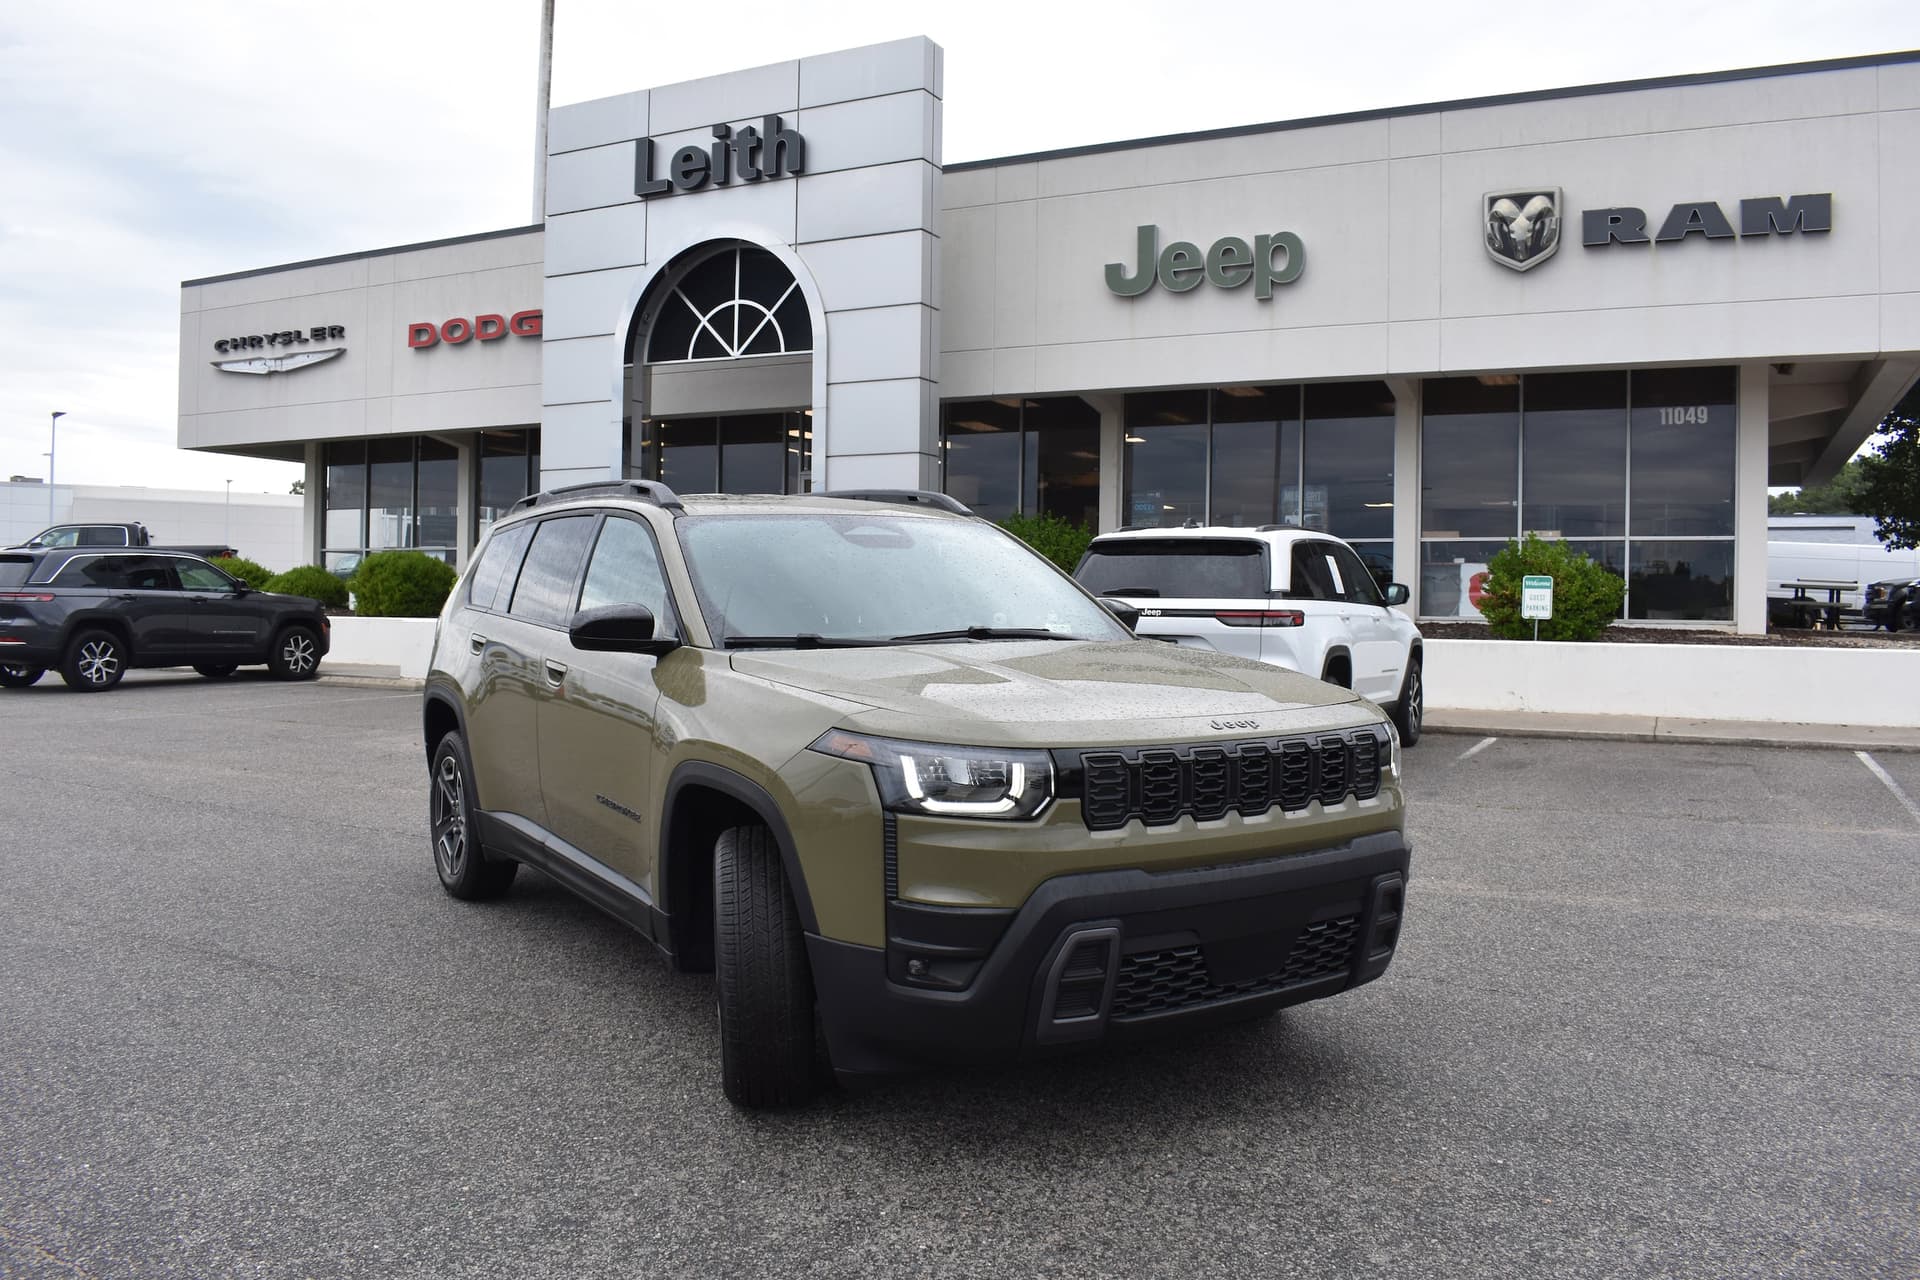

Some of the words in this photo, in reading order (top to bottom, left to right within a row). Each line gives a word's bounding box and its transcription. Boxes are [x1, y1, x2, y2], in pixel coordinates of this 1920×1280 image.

[634, 114, 805, 197] Leith
[1582, 193, 1832, 247] RAM
[1104, 224, 1306, 300] Jeep
[214, 325, 345, 353] CHRYSLER
[408, 309, 543, 349] DODG
[1660, 406, 1708, 425] 11049
[1141, 608, 1162, 617] Jeep
[1208, 719, 1261, 731] Jeep
